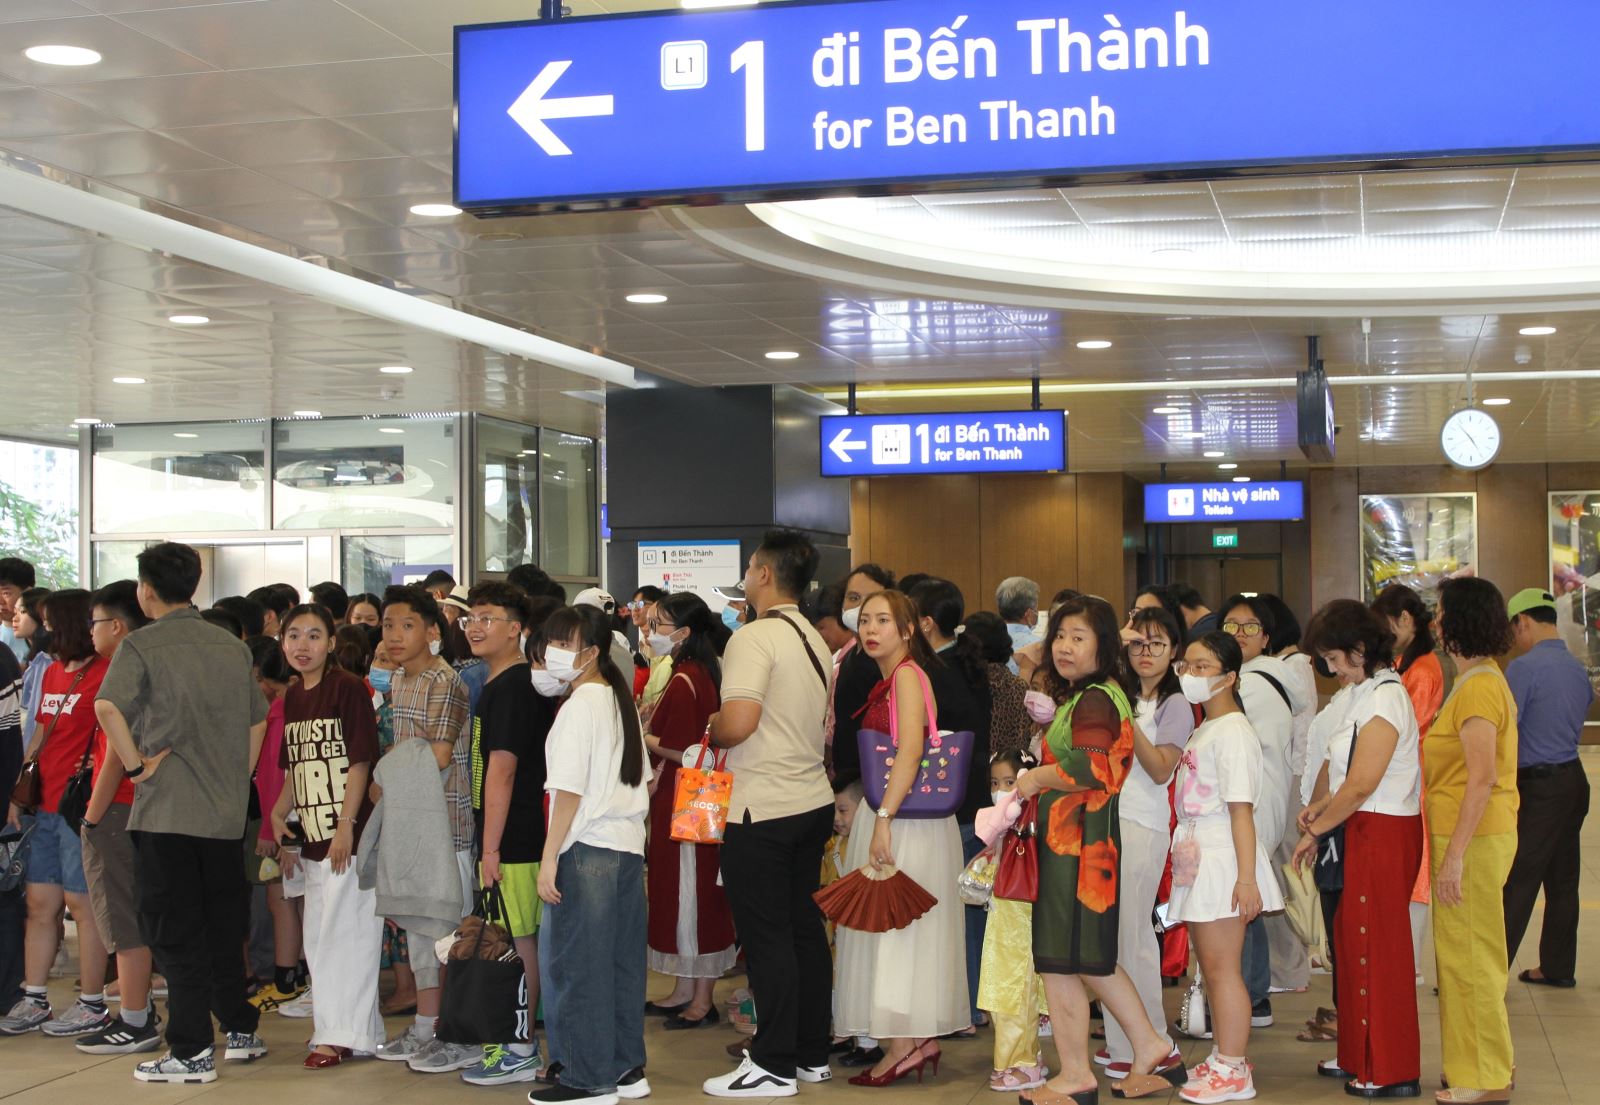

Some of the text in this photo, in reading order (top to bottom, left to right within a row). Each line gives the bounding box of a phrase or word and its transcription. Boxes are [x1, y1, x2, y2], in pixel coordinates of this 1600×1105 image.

[675, 56, 693, 74] L1
[730, 10, 1210, 152] 1 đi Bến Thành
[812, 95, 1116, 150] for Ben Thanh
[915, 420, 1050, 464] 1 đi Bến Thành
[934, 446, 1023, 462] for Ben Thanh
[1202, 487, 1230, 502] Nhà
[1250, 487, 1280, 501] sinh
[1216, 535, 1234, 546] EXIT
[289, 757, 349, 807] ORE
